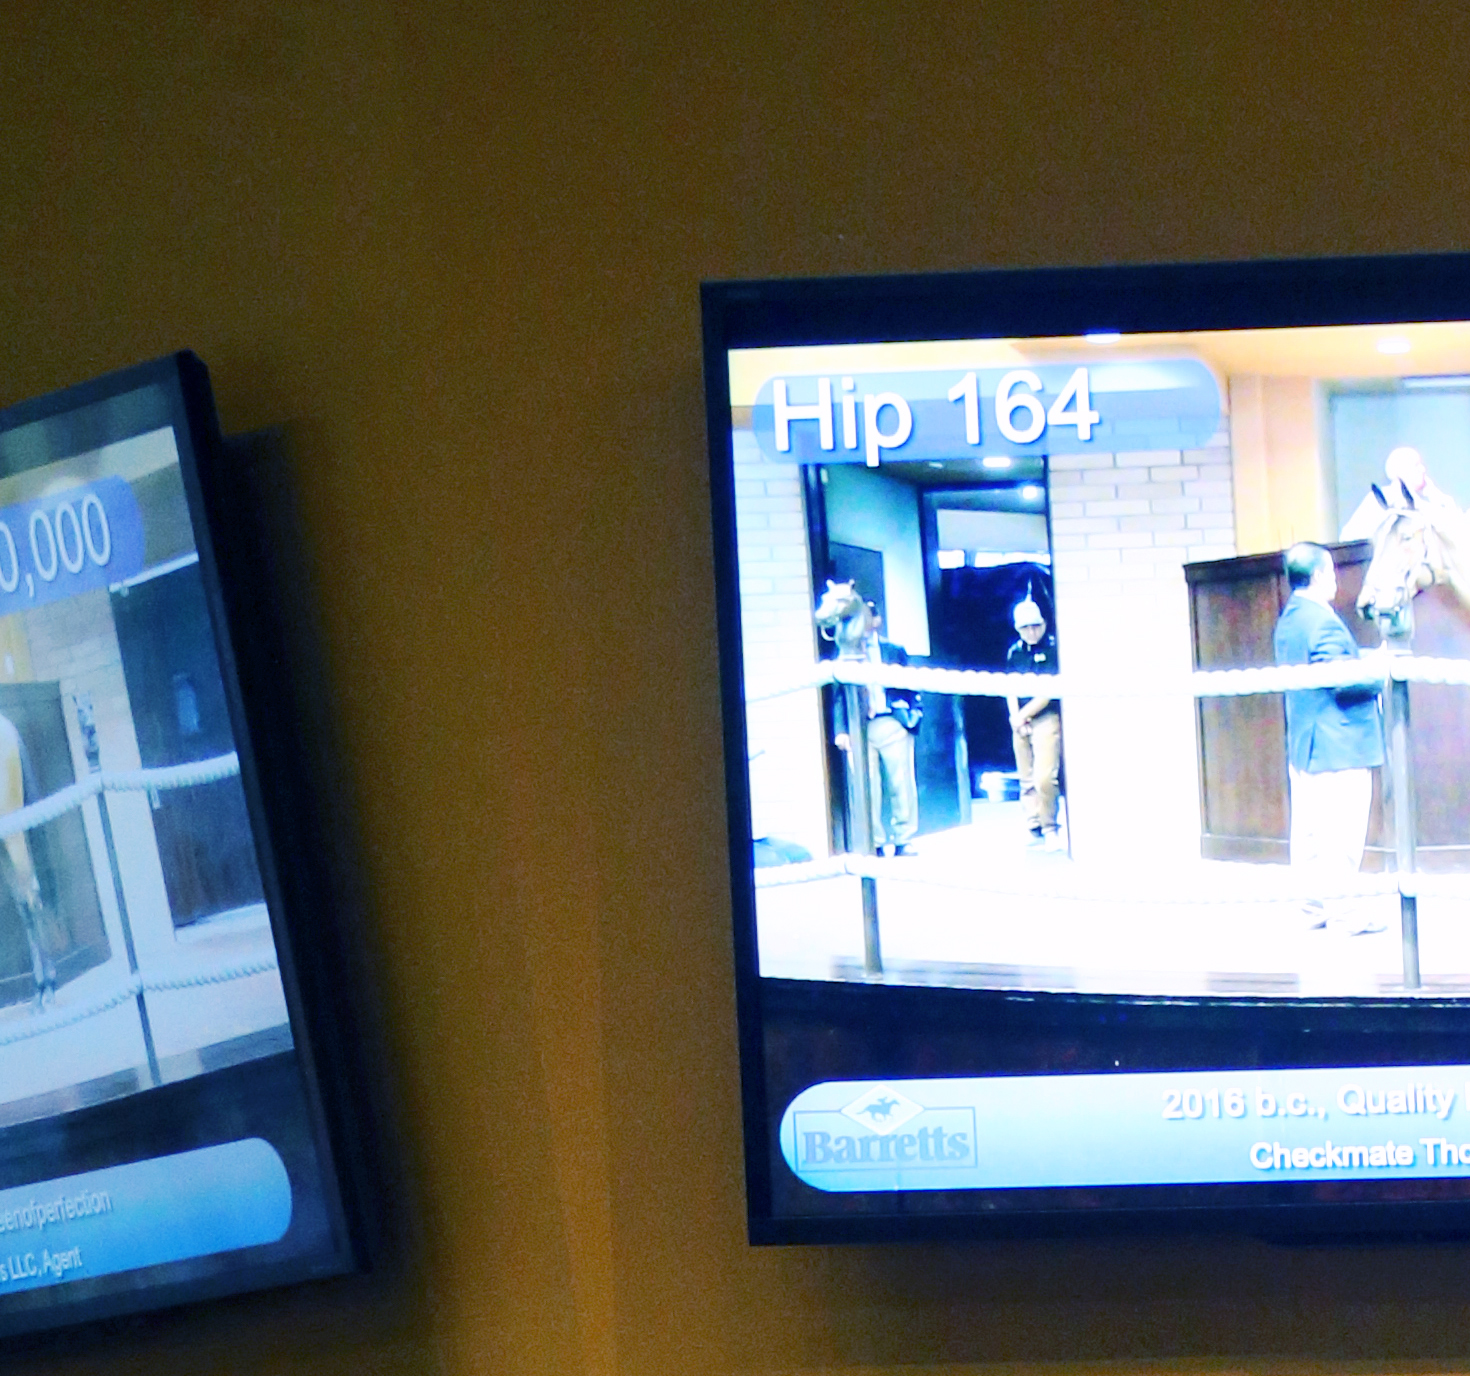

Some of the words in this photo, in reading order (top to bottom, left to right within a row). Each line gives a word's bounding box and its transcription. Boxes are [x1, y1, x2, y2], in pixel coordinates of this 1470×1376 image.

[773, 376, 914, 468] Hip
[946, 366, 1101, 446] 164
[1161, 1086, 1248, 1120] 2016
[1254, 1085, 1328, 1121] b.c.,
[1336, 1081, 1455, 1120] Quality
[802, 1126, 971, 1165] Barretts
[1250, 1139, 1416, 1170] Checkmate
[43, 1246, 83, 1278] Agent
